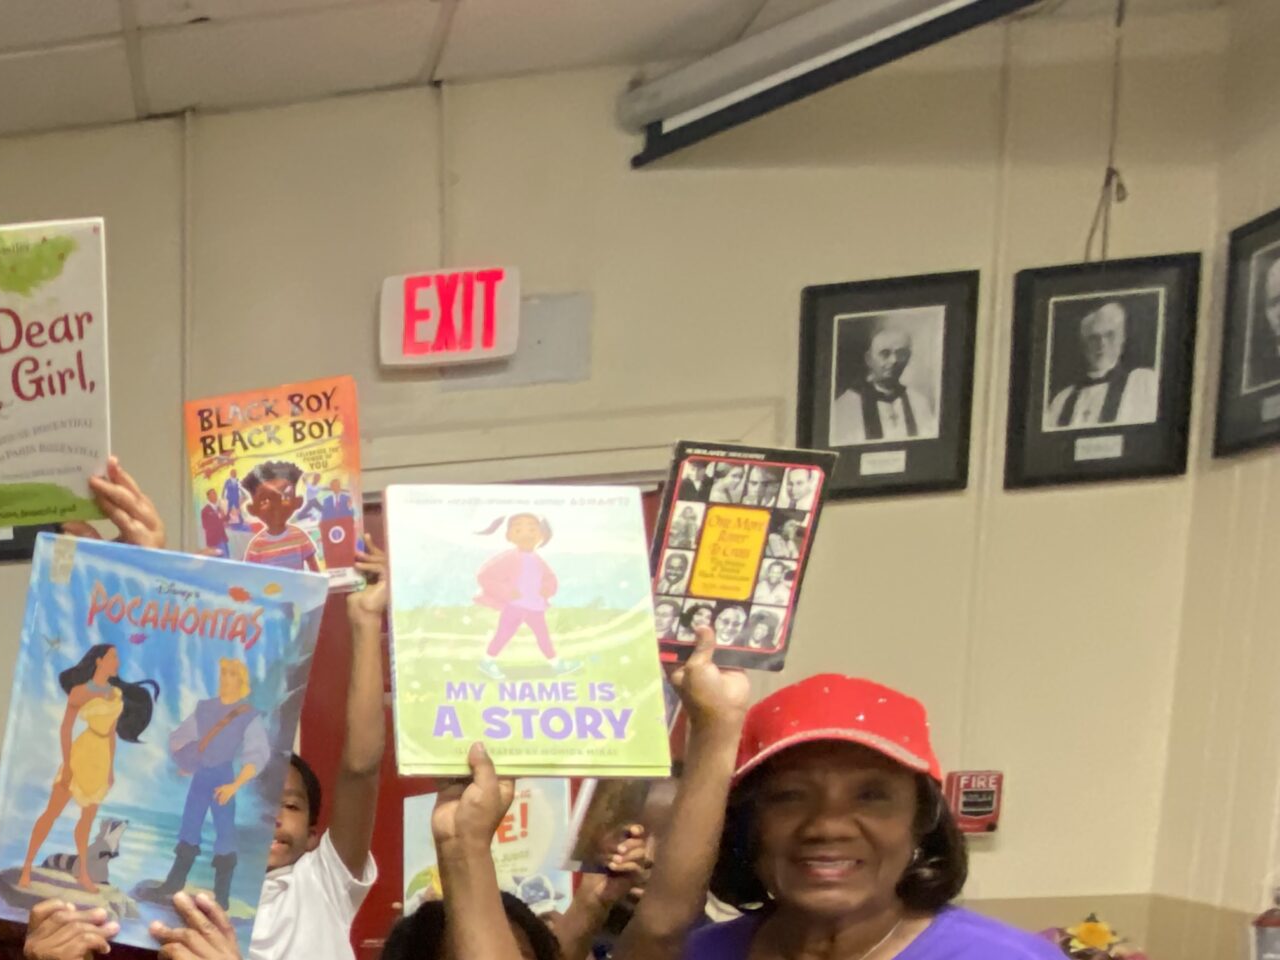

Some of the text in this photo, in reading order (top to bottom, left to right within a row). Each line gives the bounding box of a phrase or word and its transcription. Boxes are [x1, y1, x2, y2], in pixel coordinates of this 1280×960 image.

[402, 267, 505, 356] EXIT
[11, 350, 96, 402] Girl,
[198, 398, 280, 432] BLACK
[200, 414, 338, 459] BLACK BOY
[309, 461, 329, 470] YOU
[87, 579, 265, 650] POCAHONTAS
[445, 681, 617, 702] MY NAME IS
[431, 705, 634, 741] A STORY
[960, 775, 998, 789] FIRE
